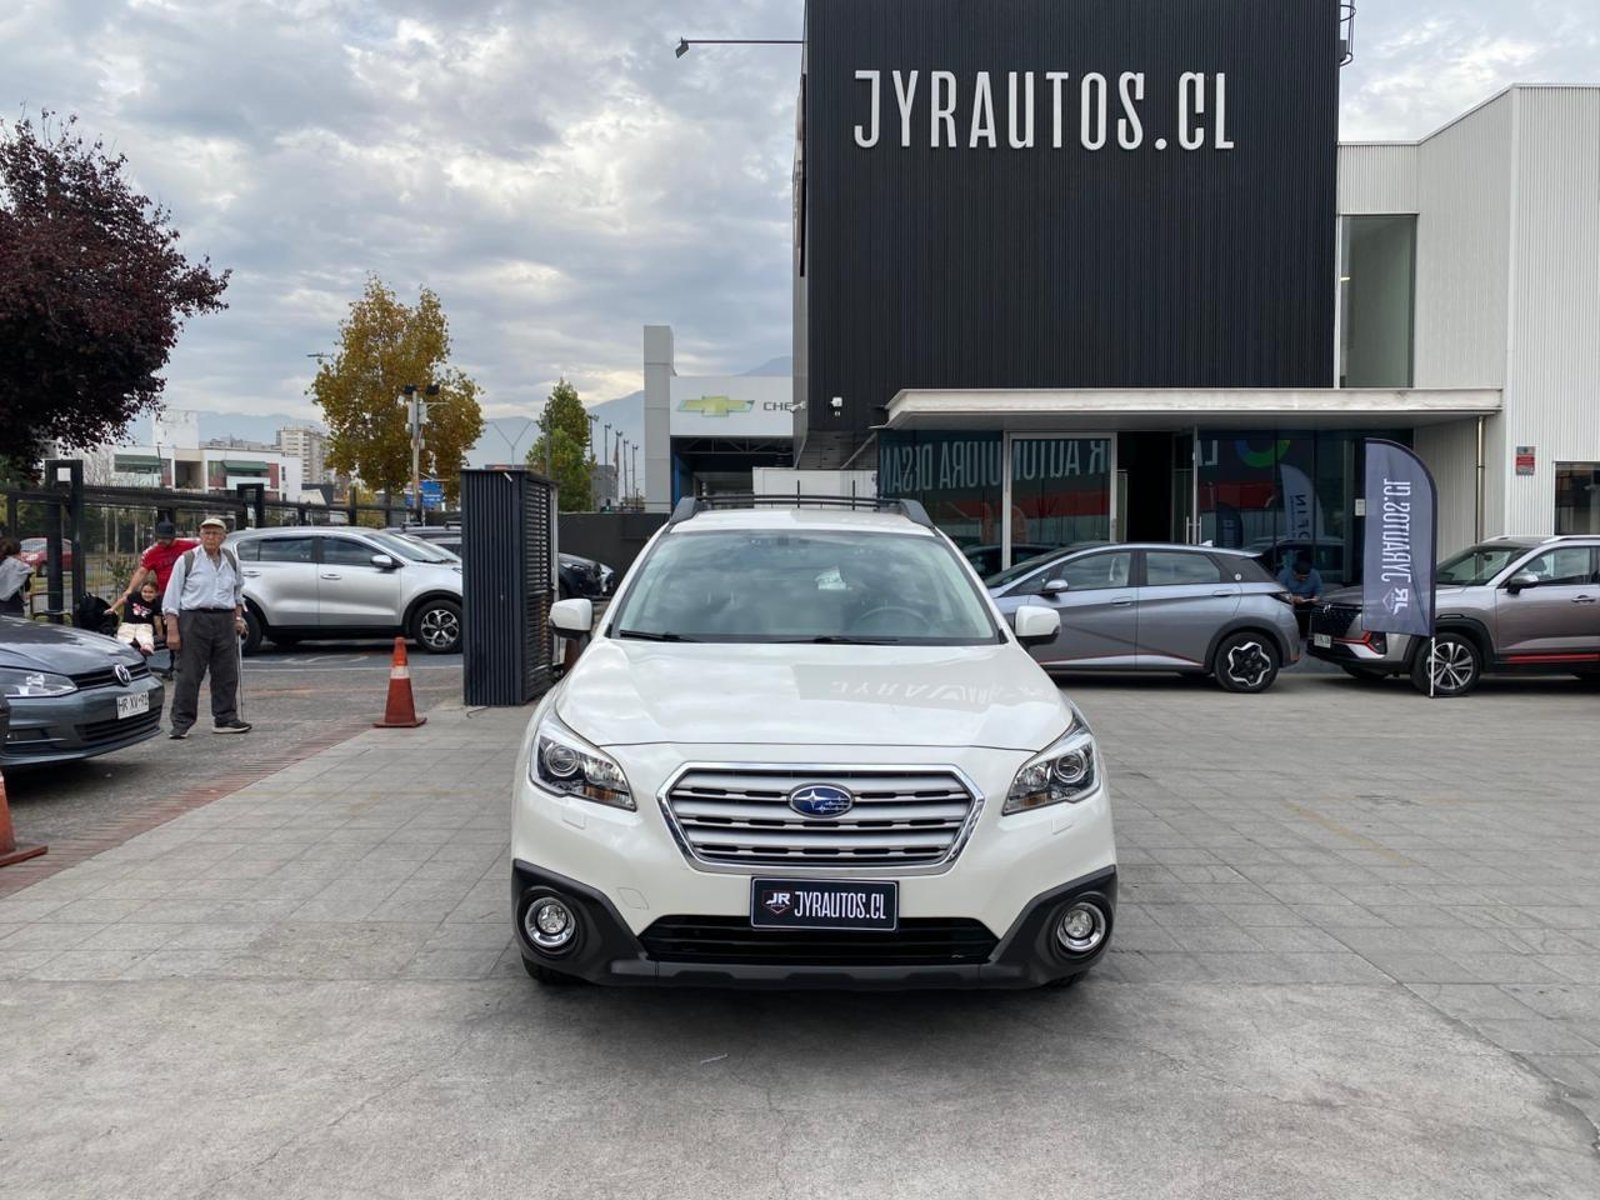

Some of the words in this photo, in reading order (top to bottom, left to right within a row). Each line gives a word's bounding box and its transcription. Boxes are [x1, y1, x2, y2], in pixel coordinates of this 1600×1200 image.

[854, 70, 1234, 151] JYRAUTOS.CL
[763, 401, 795, 411] CHE
[794, 891, 887, 920] JYRAUTOS.CL
